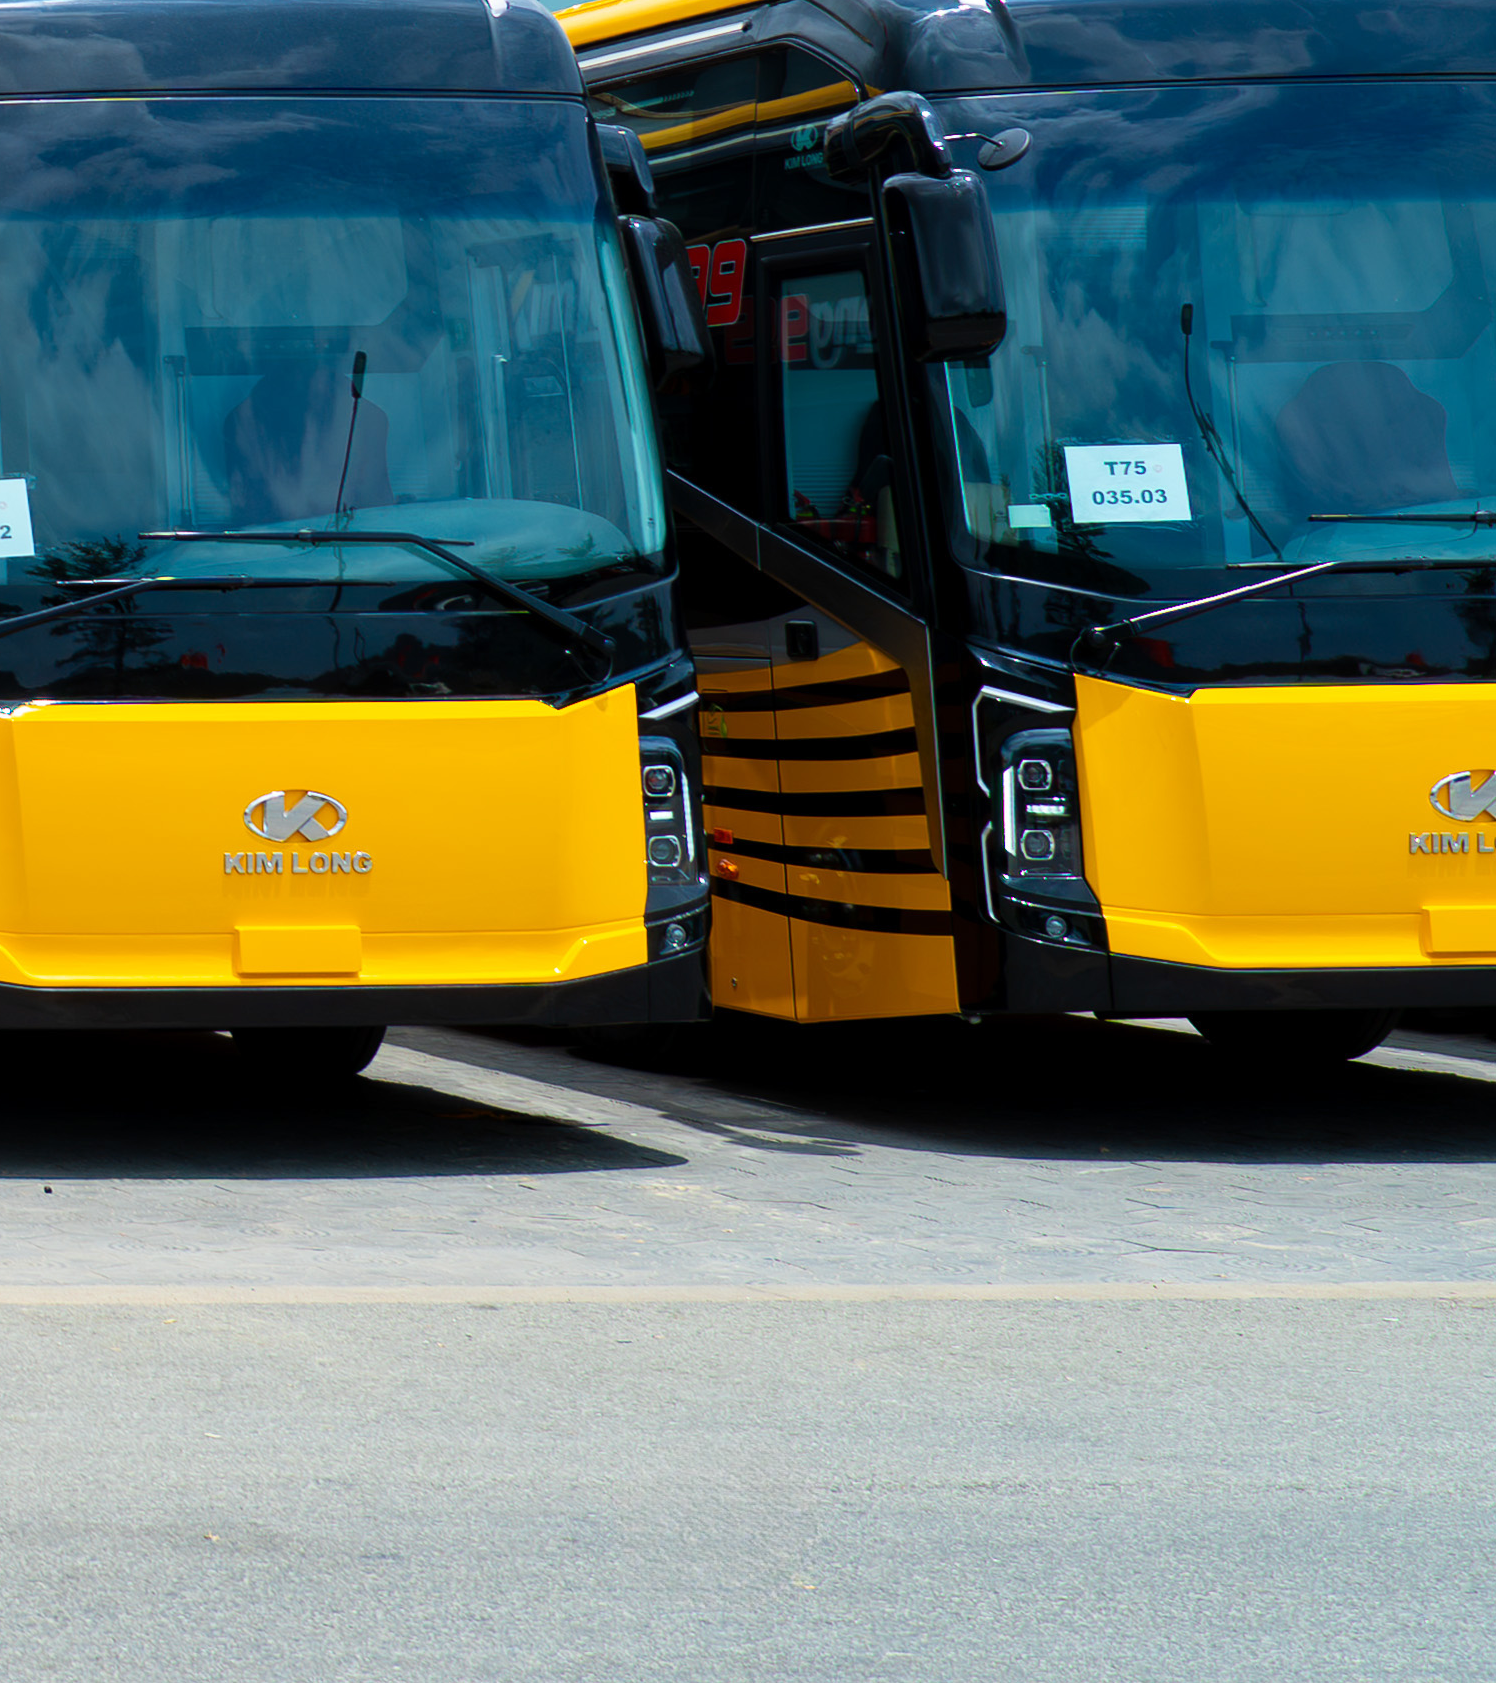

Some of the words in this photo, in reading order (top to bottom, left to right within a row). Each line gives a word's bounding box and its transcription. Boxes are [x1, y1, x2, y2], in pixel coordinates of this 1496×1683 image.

[1103, 460, 1147, 476] T75
[1091, 488, 1168, 505] 035.03
[1409, 831, 1470, 854] KIM
[223, 851, 284, 875] KIM
[292, 851, 374, 875] LONG
